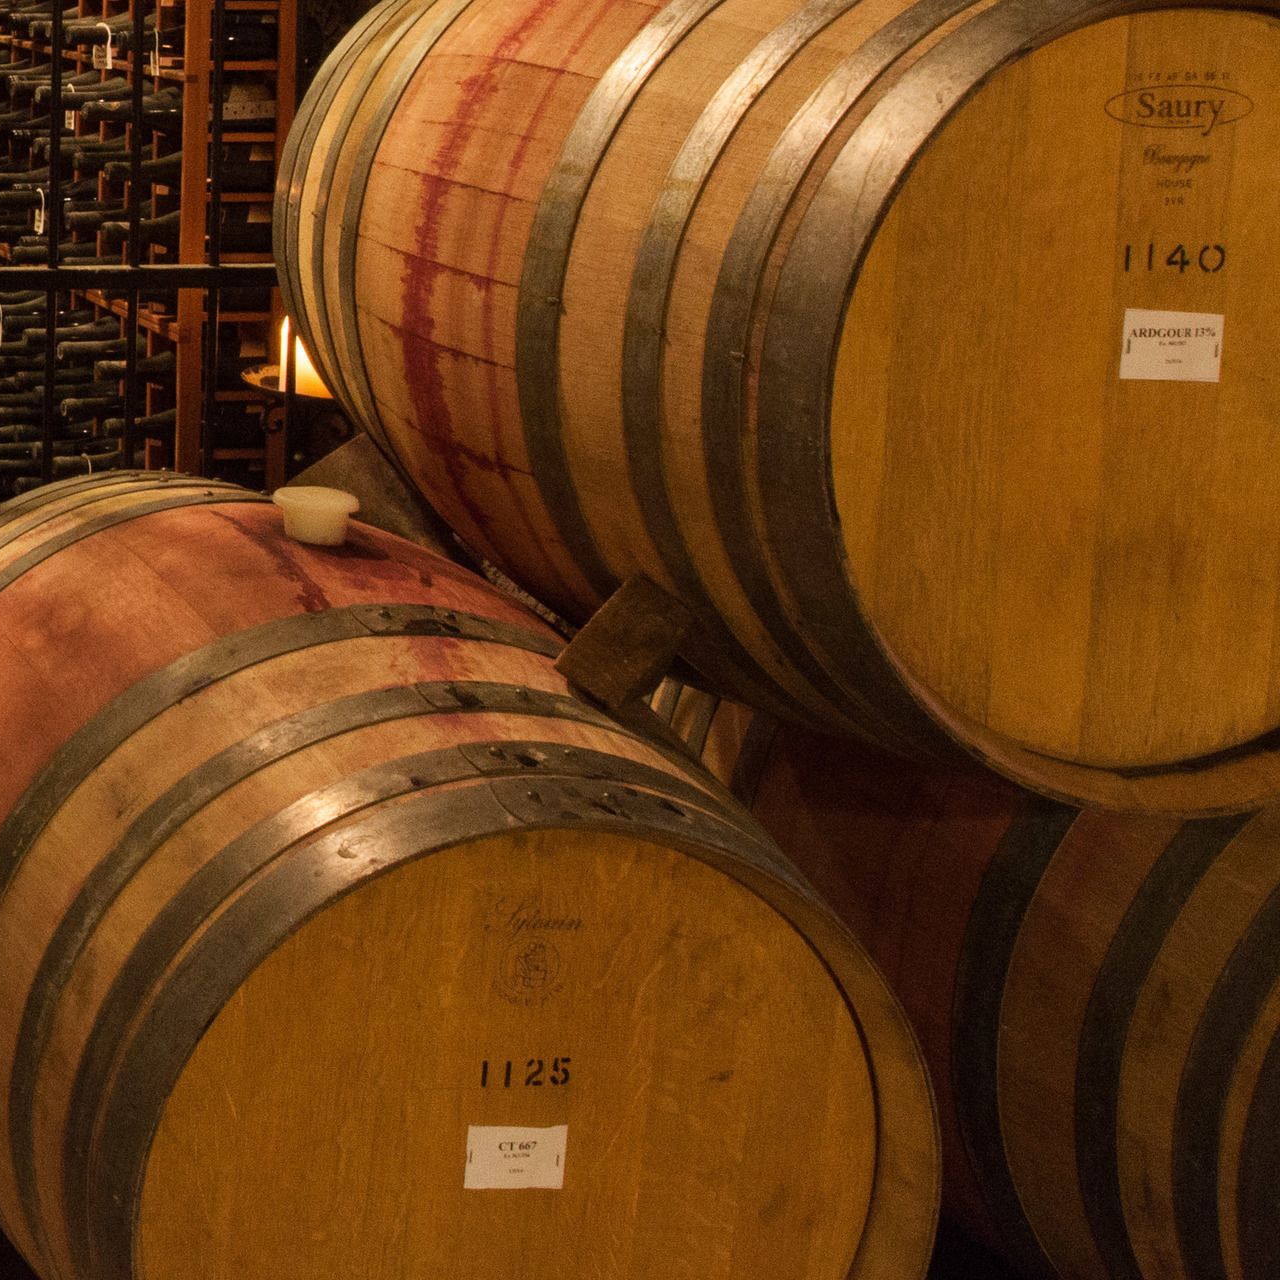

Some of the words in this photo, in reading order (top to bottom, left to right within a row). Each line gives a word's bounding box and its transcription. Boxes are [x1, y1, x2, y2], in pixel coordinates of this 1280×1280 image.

[1136, 92, 1225, 136] Saury
[1124, 243, 1226, 273] 1140
[1129, 328, 1191, 338] ARDGOUR
[481, 1057, 572, 1088] 1125
[498, 1141, 516, 1152] CT
[518, 1141, 538, 1151] 667
